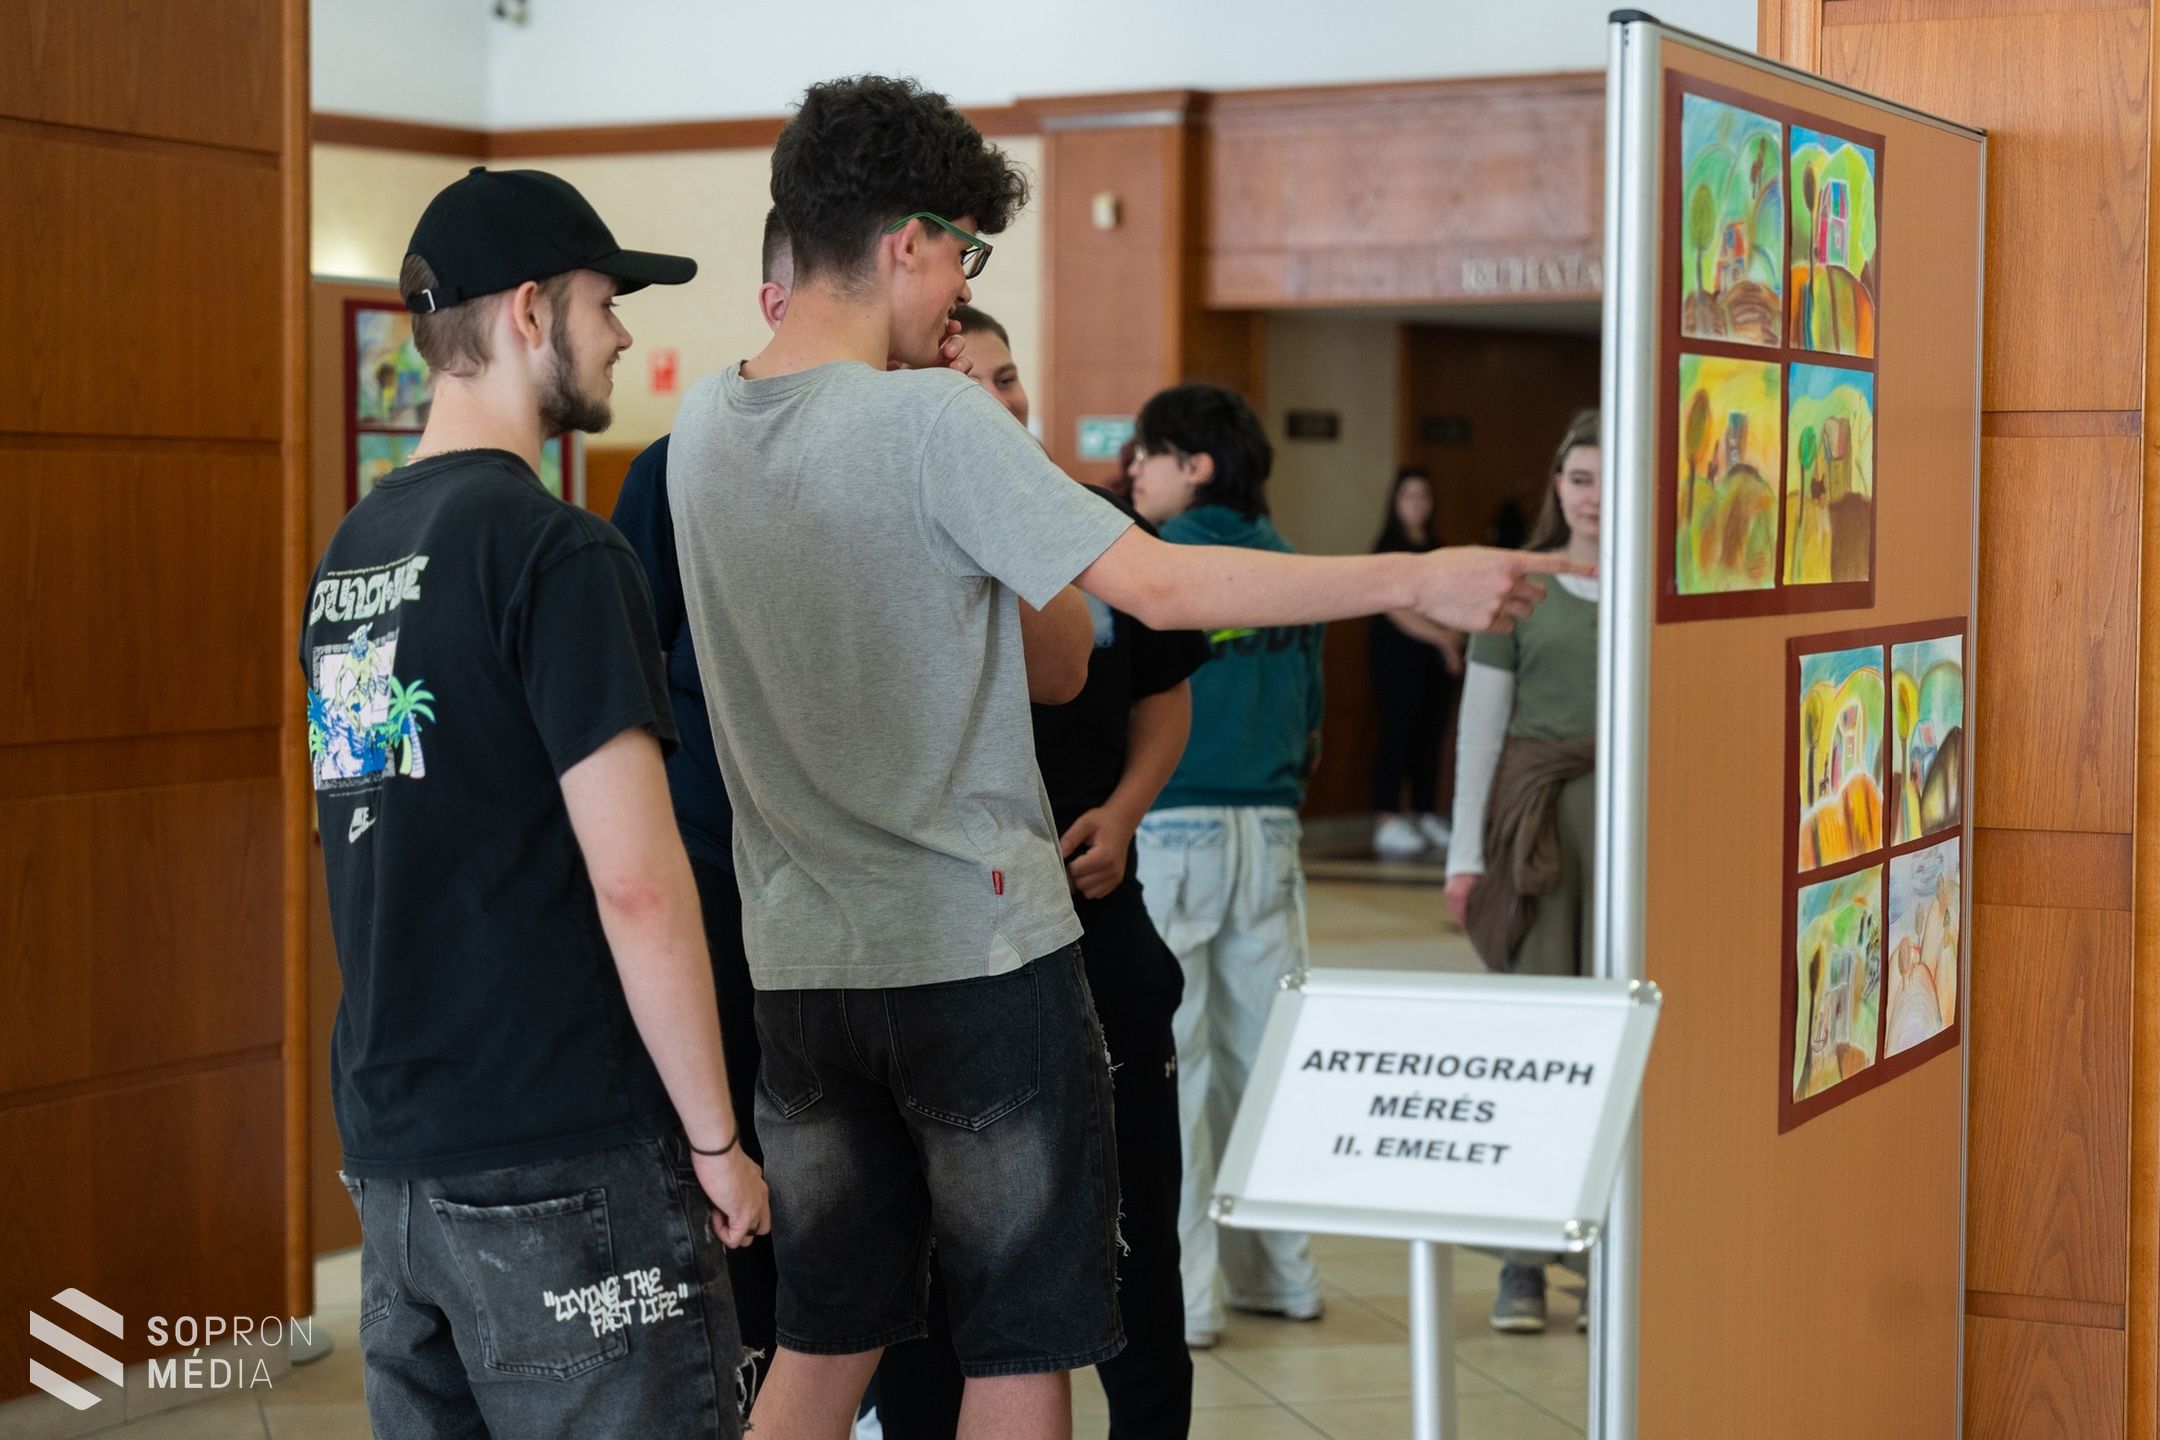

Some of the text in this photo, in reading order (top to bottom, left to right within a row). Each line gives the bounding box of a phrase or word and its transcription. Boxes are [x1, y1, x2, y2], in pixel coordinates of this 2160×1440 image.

[1301, 1049, 1595, 1086] ARTERIOGRAPH
[1368, 1090, 1498, 1124] MÉRÉS
[1332, 1134, 1511, 1166] II. EMELET
[623, 1266, 664, 1299] THE
[588, 1298, 636, 1338] FAST
